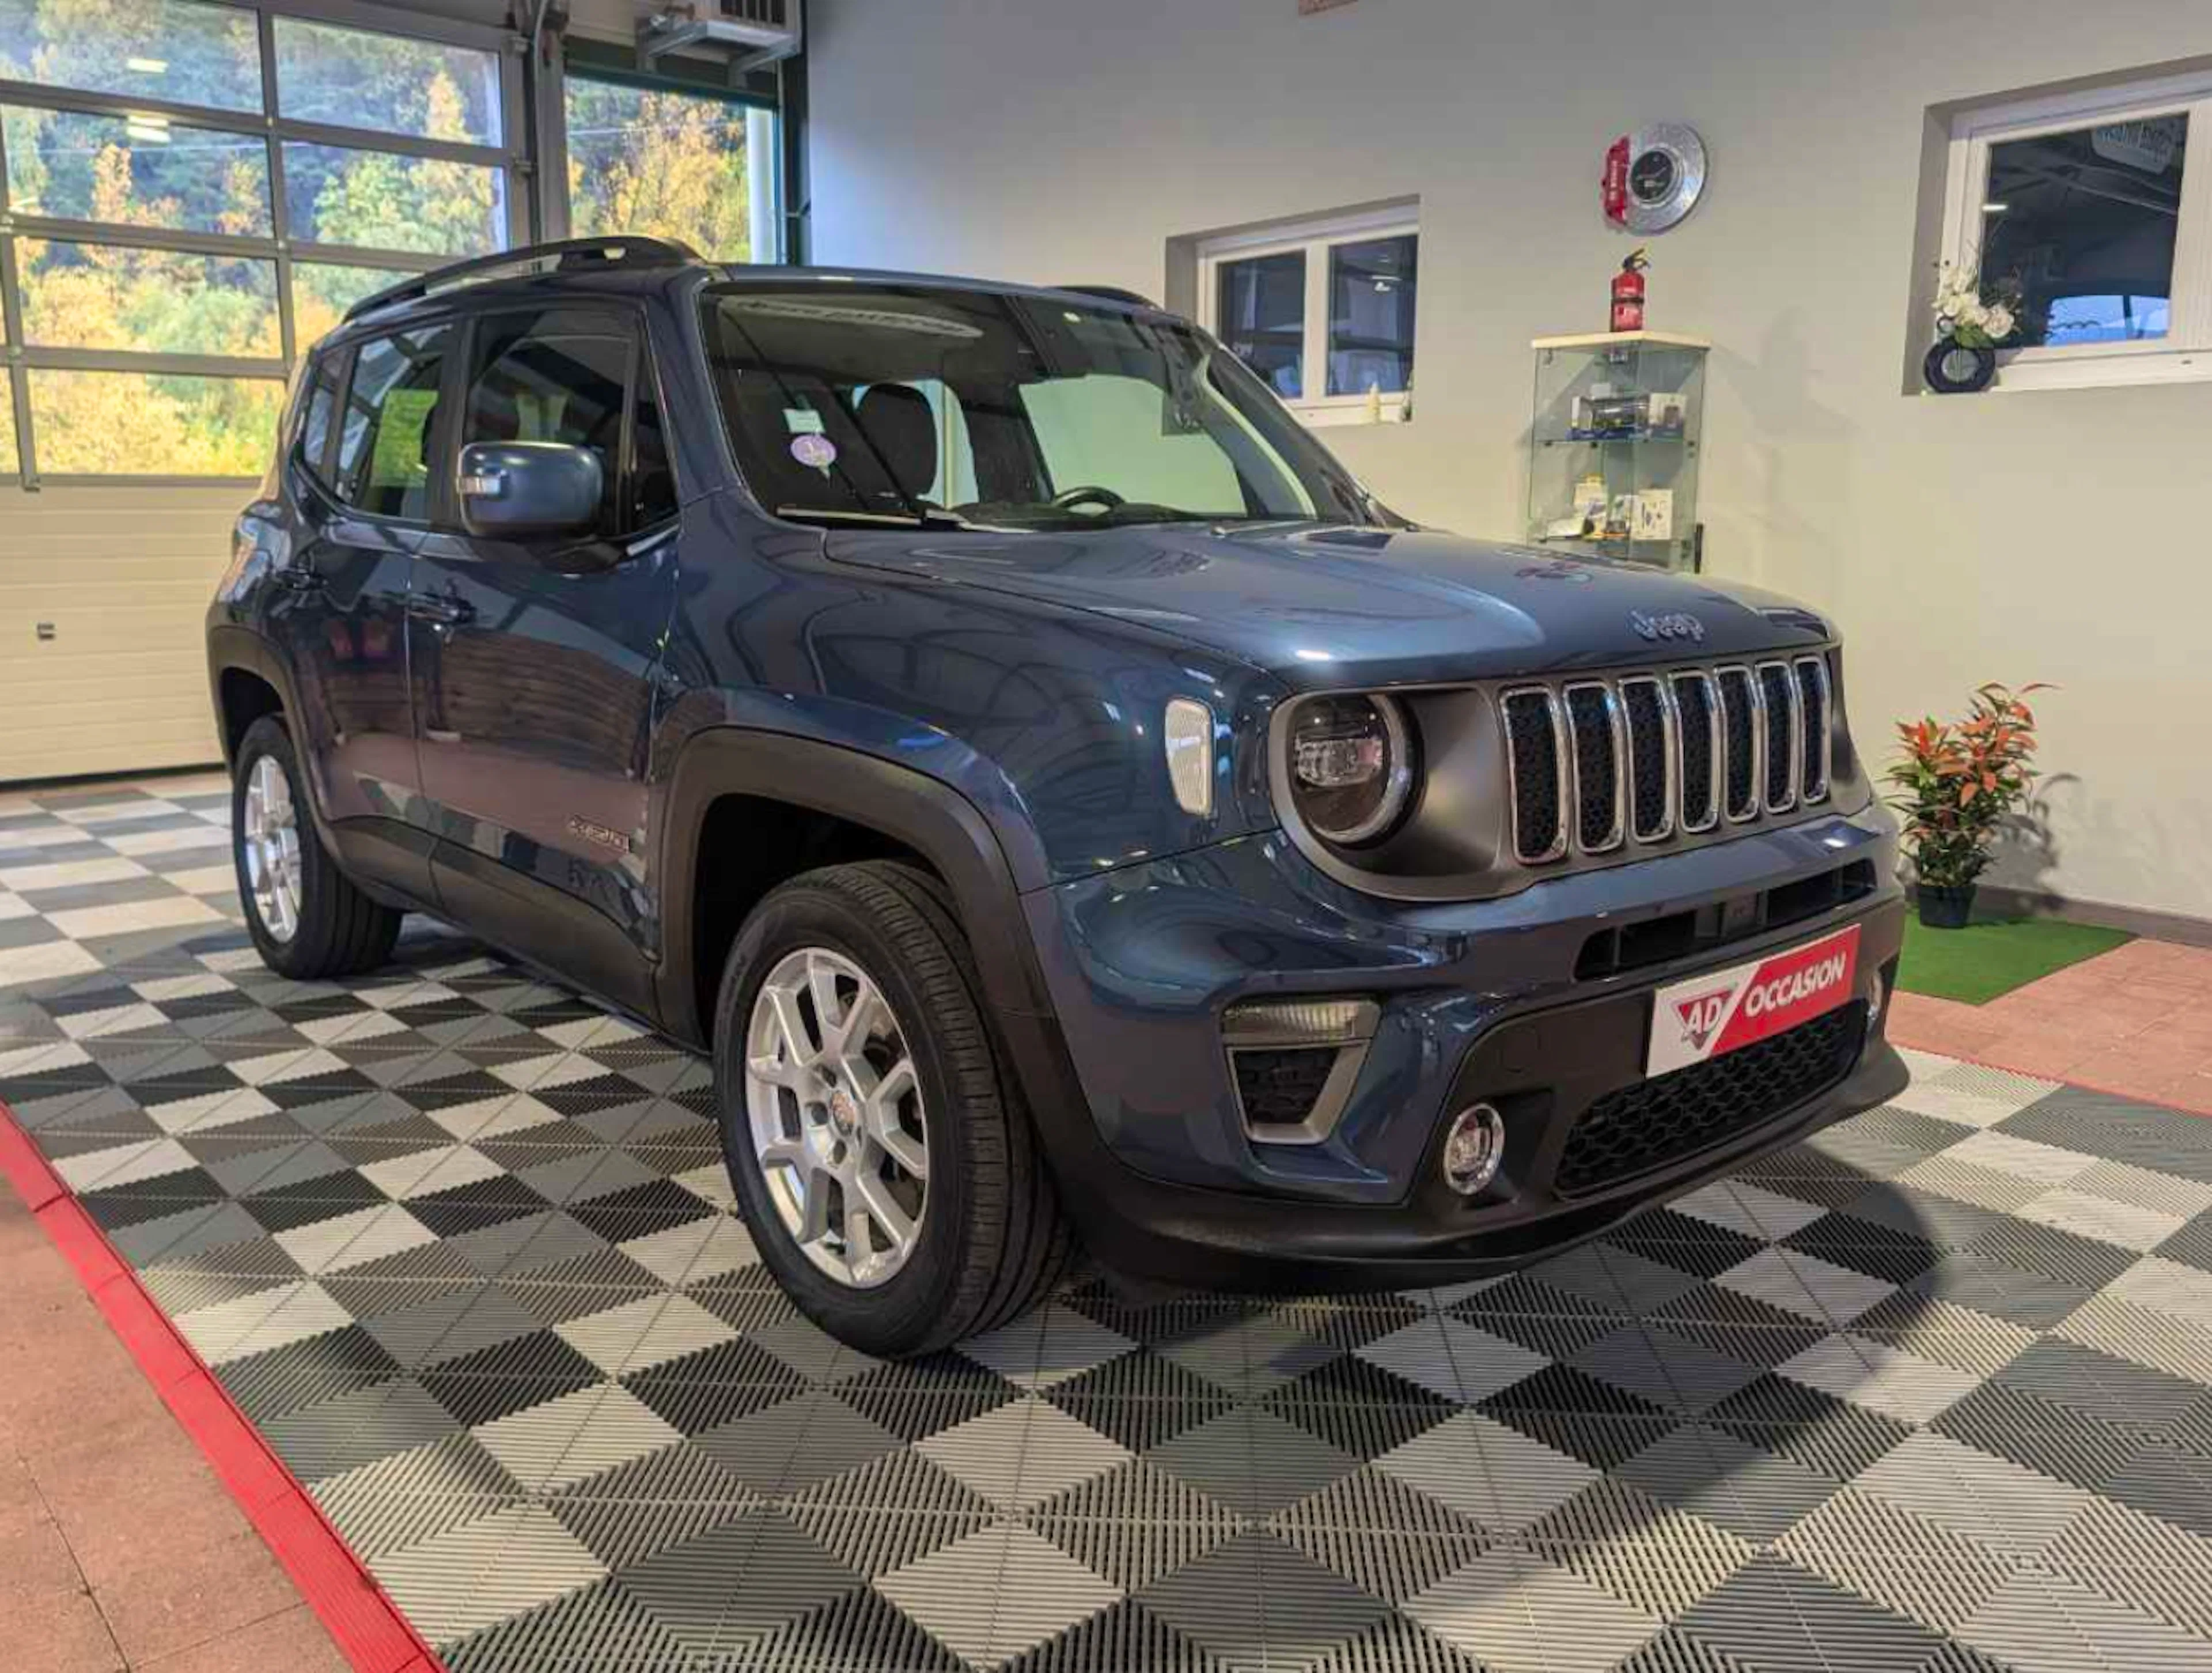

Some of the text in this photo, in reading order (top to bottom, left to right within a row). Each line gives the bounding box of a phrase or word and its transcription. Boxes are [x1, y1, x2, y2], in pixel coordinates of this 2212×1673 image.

[1630, 610, 1705, 641] Jeep
[1685, 951, 1846, 1035] AD OCCASION
